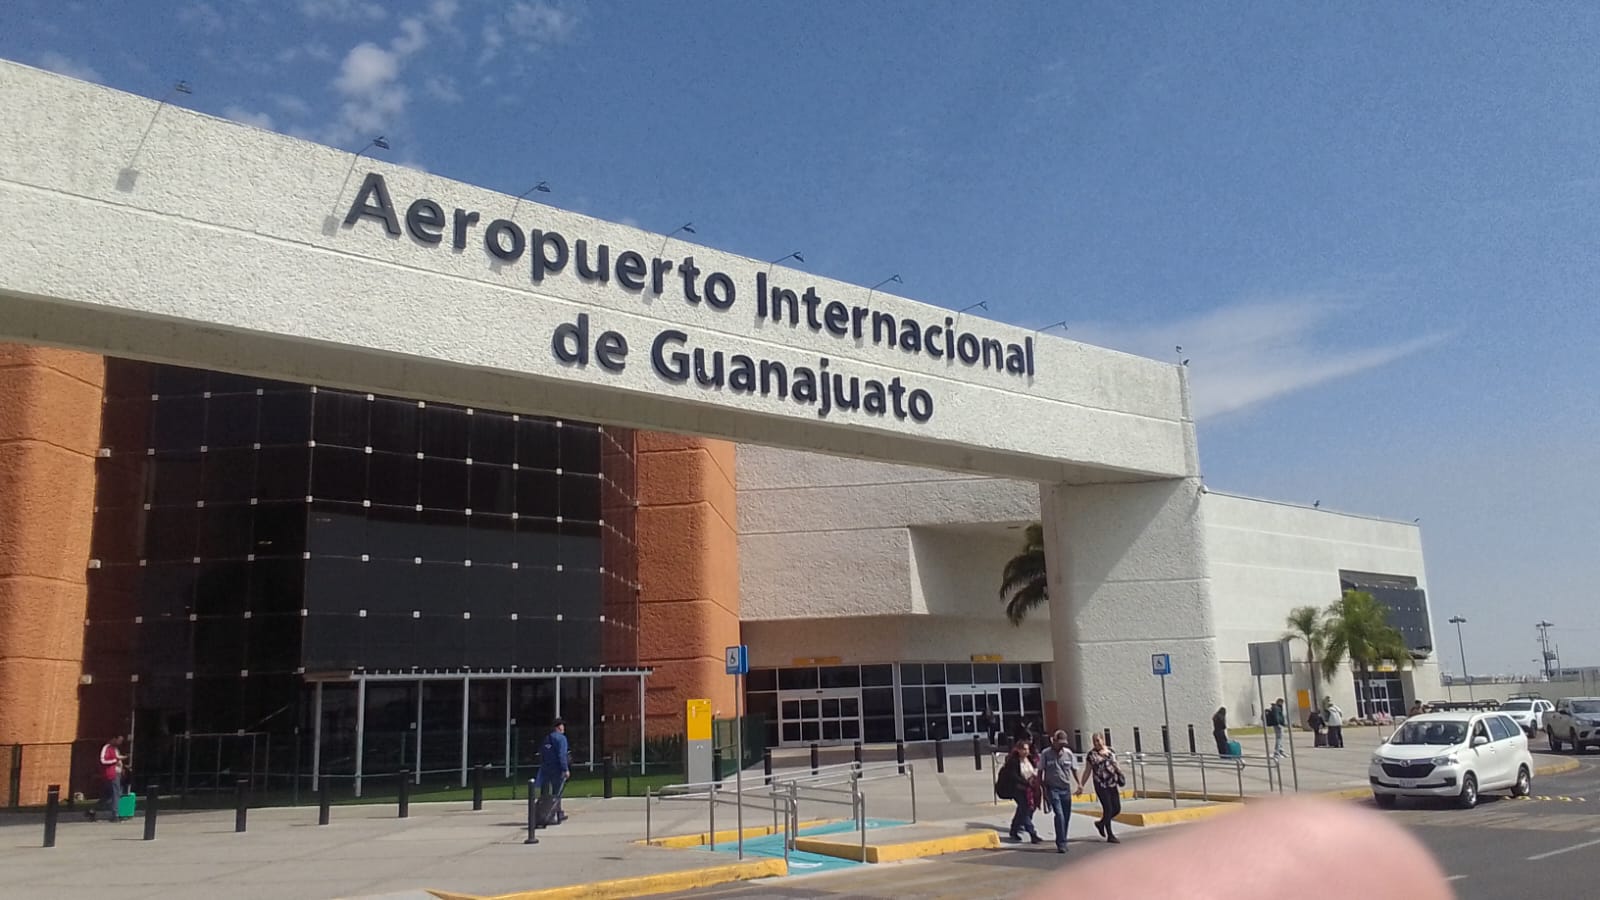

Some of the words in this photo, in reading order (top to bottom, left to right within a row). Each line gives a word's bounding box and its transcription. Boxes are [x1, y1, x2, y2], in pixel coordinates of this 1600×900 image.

[343, 172, 735, 311] Aeropuerto
[756, 271, 1035, 378] Internacional
[551, 312, 628, 374] de
[650, 329, 934, 422] Guanajuato
